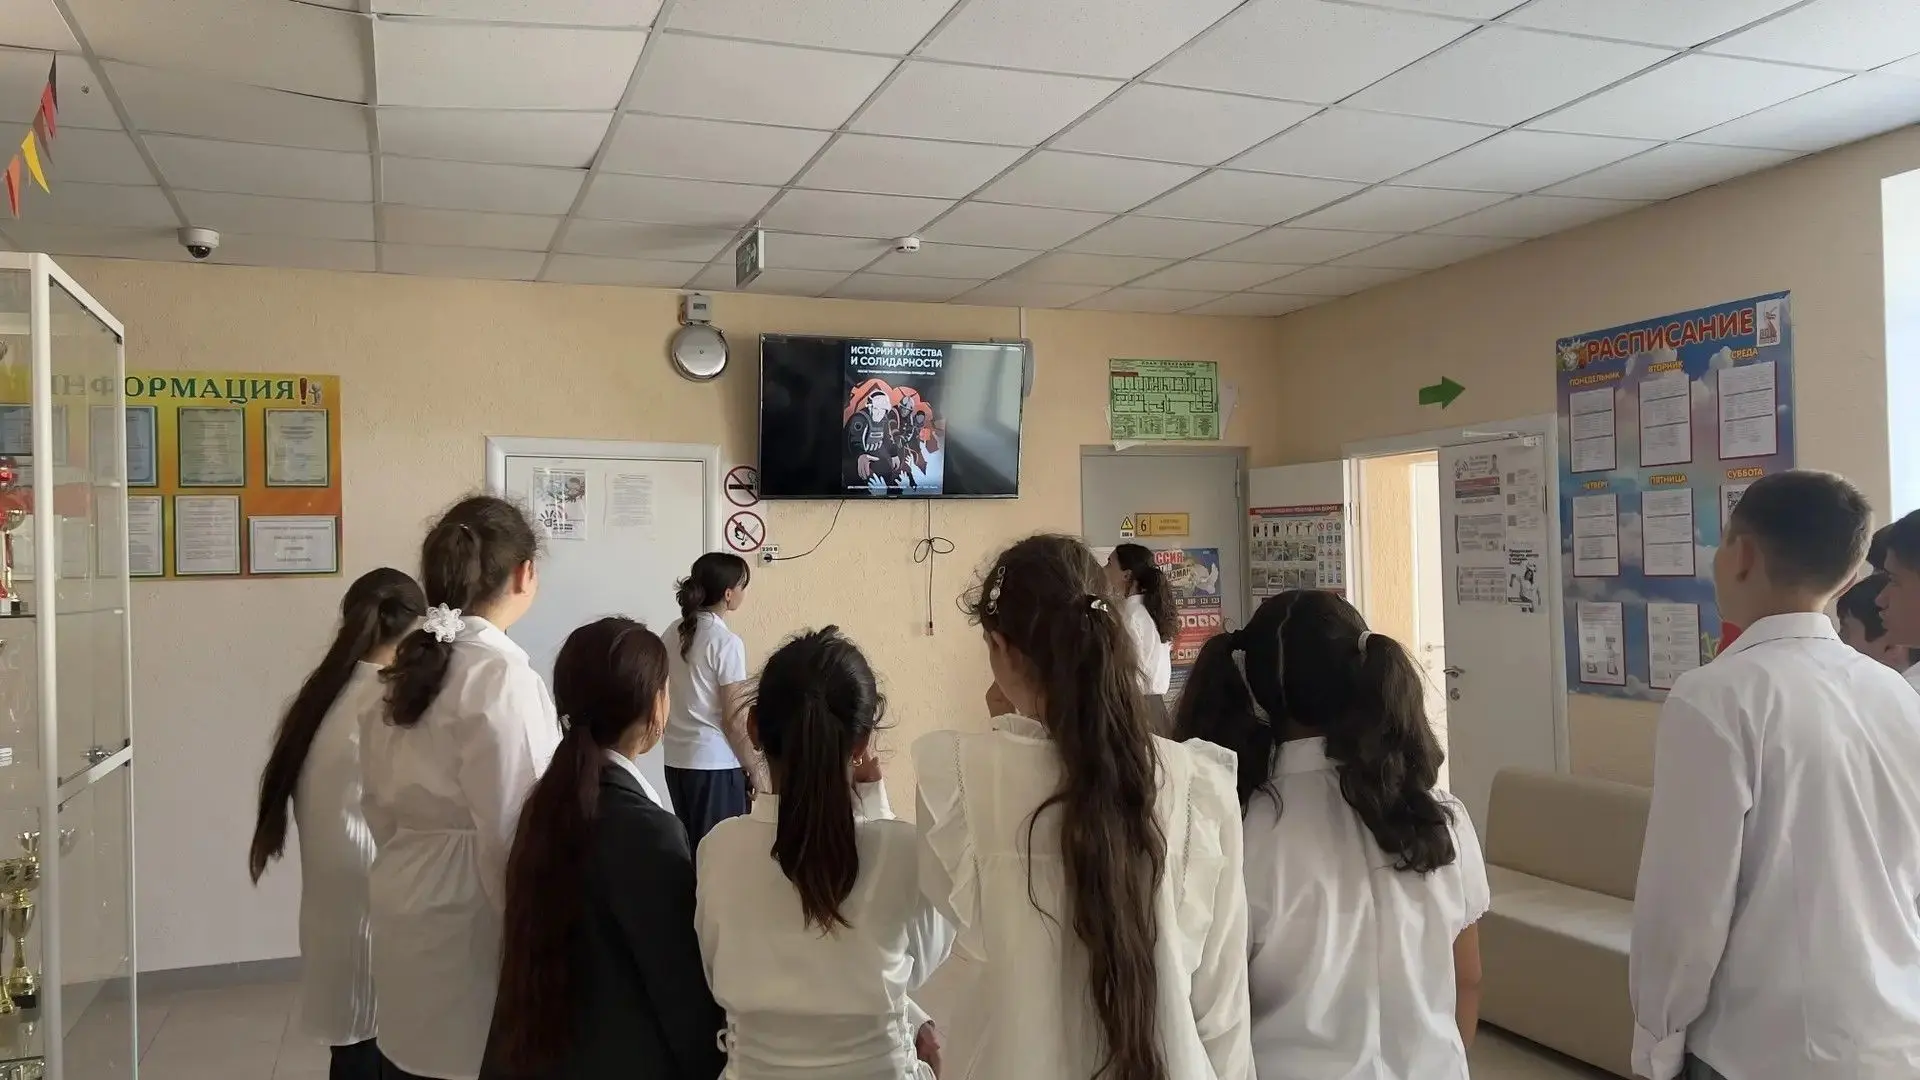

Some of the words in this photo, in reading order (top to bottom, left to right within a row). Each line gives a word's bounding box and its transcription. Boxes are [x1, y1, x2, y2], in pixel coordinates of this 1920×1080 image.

[1585, 308, 1755, 364] РАСПИСАНИЕ
[850, 346, 893, 355] ИСТОРИИ
[895, 348, 943, 357] МУЖЕСТВА
[1731, 347, 1759, 360] СРЕДА
[850, 356, 858, 365] И
[860, 356, 942, 368] СОЛИДАРНОСТИ
[1648, 361, 1684, 373] ВТОРНИК
[1569, 372, 1621, 386] ПОНЕДЕЛЬНИК
[1727, 468, 1764, 479] СУББОТА
[1650, 475, 1687, 486] ПЯТНИЦА
[1141, 519, 1147, 532] 6
[1155, 552, 1184, 565] ССИЯ
